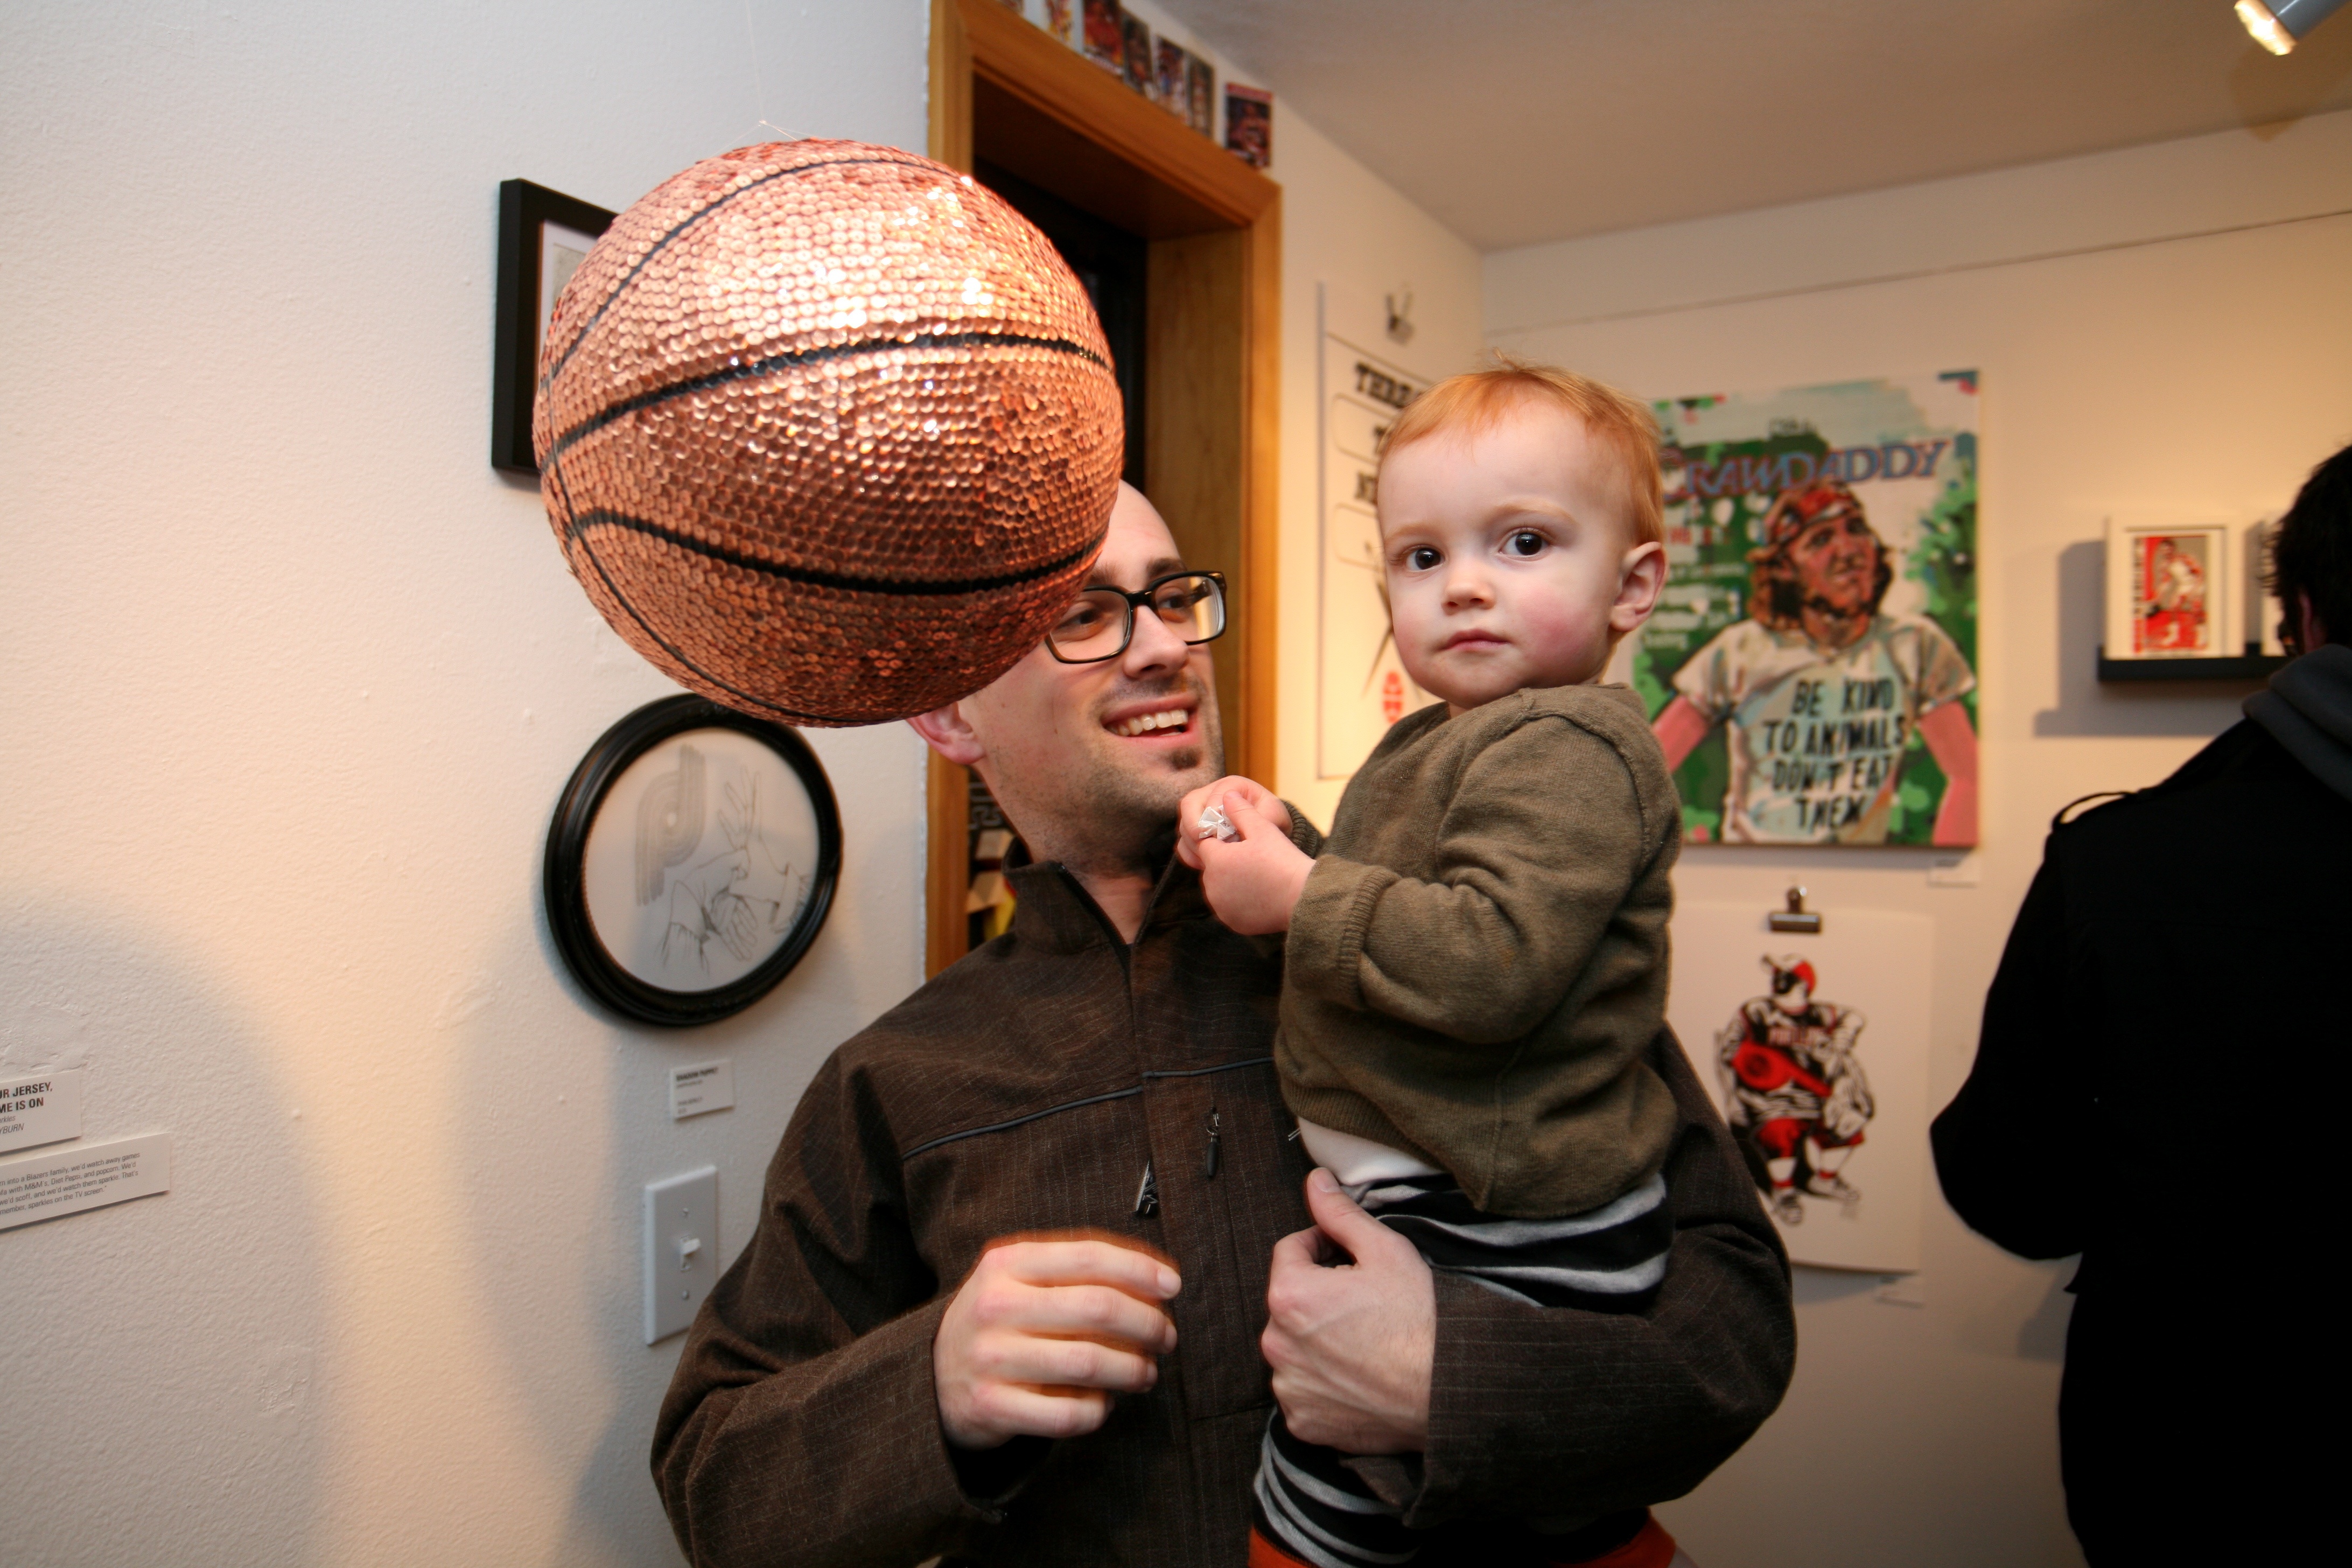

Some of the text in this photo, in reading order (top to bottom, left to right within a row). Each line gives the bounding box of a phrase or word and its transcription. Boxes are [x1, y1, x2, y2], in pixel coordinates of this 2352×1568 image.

[1792, 676, 1895, 718] BE KIND
[1763, 714, 1906, 755] TO ANIMALS
[1851, 755, 1892, 790] EAT
[1794, 794, 1867, 832] THEM
[12, 1081, 53, 1097] JERSEY,
[16, 1100, 26, 1110] IS
[29, 1097, 44, 1108] ON
[26, 1172, 48, 1181] Blazers
[87, 1159, 104, 1168] watch
[122, 1152, 140, 1162] games
[9, 1186, 23, 1194] with
[51, 1177, 64, 1185] Diet
[34, 1190, 45, 1198] and
[62, 1182, 81, 1192] watch
[82, 1179, 97, 1187] them
[28, 1198, 53, 1209] sparkles
